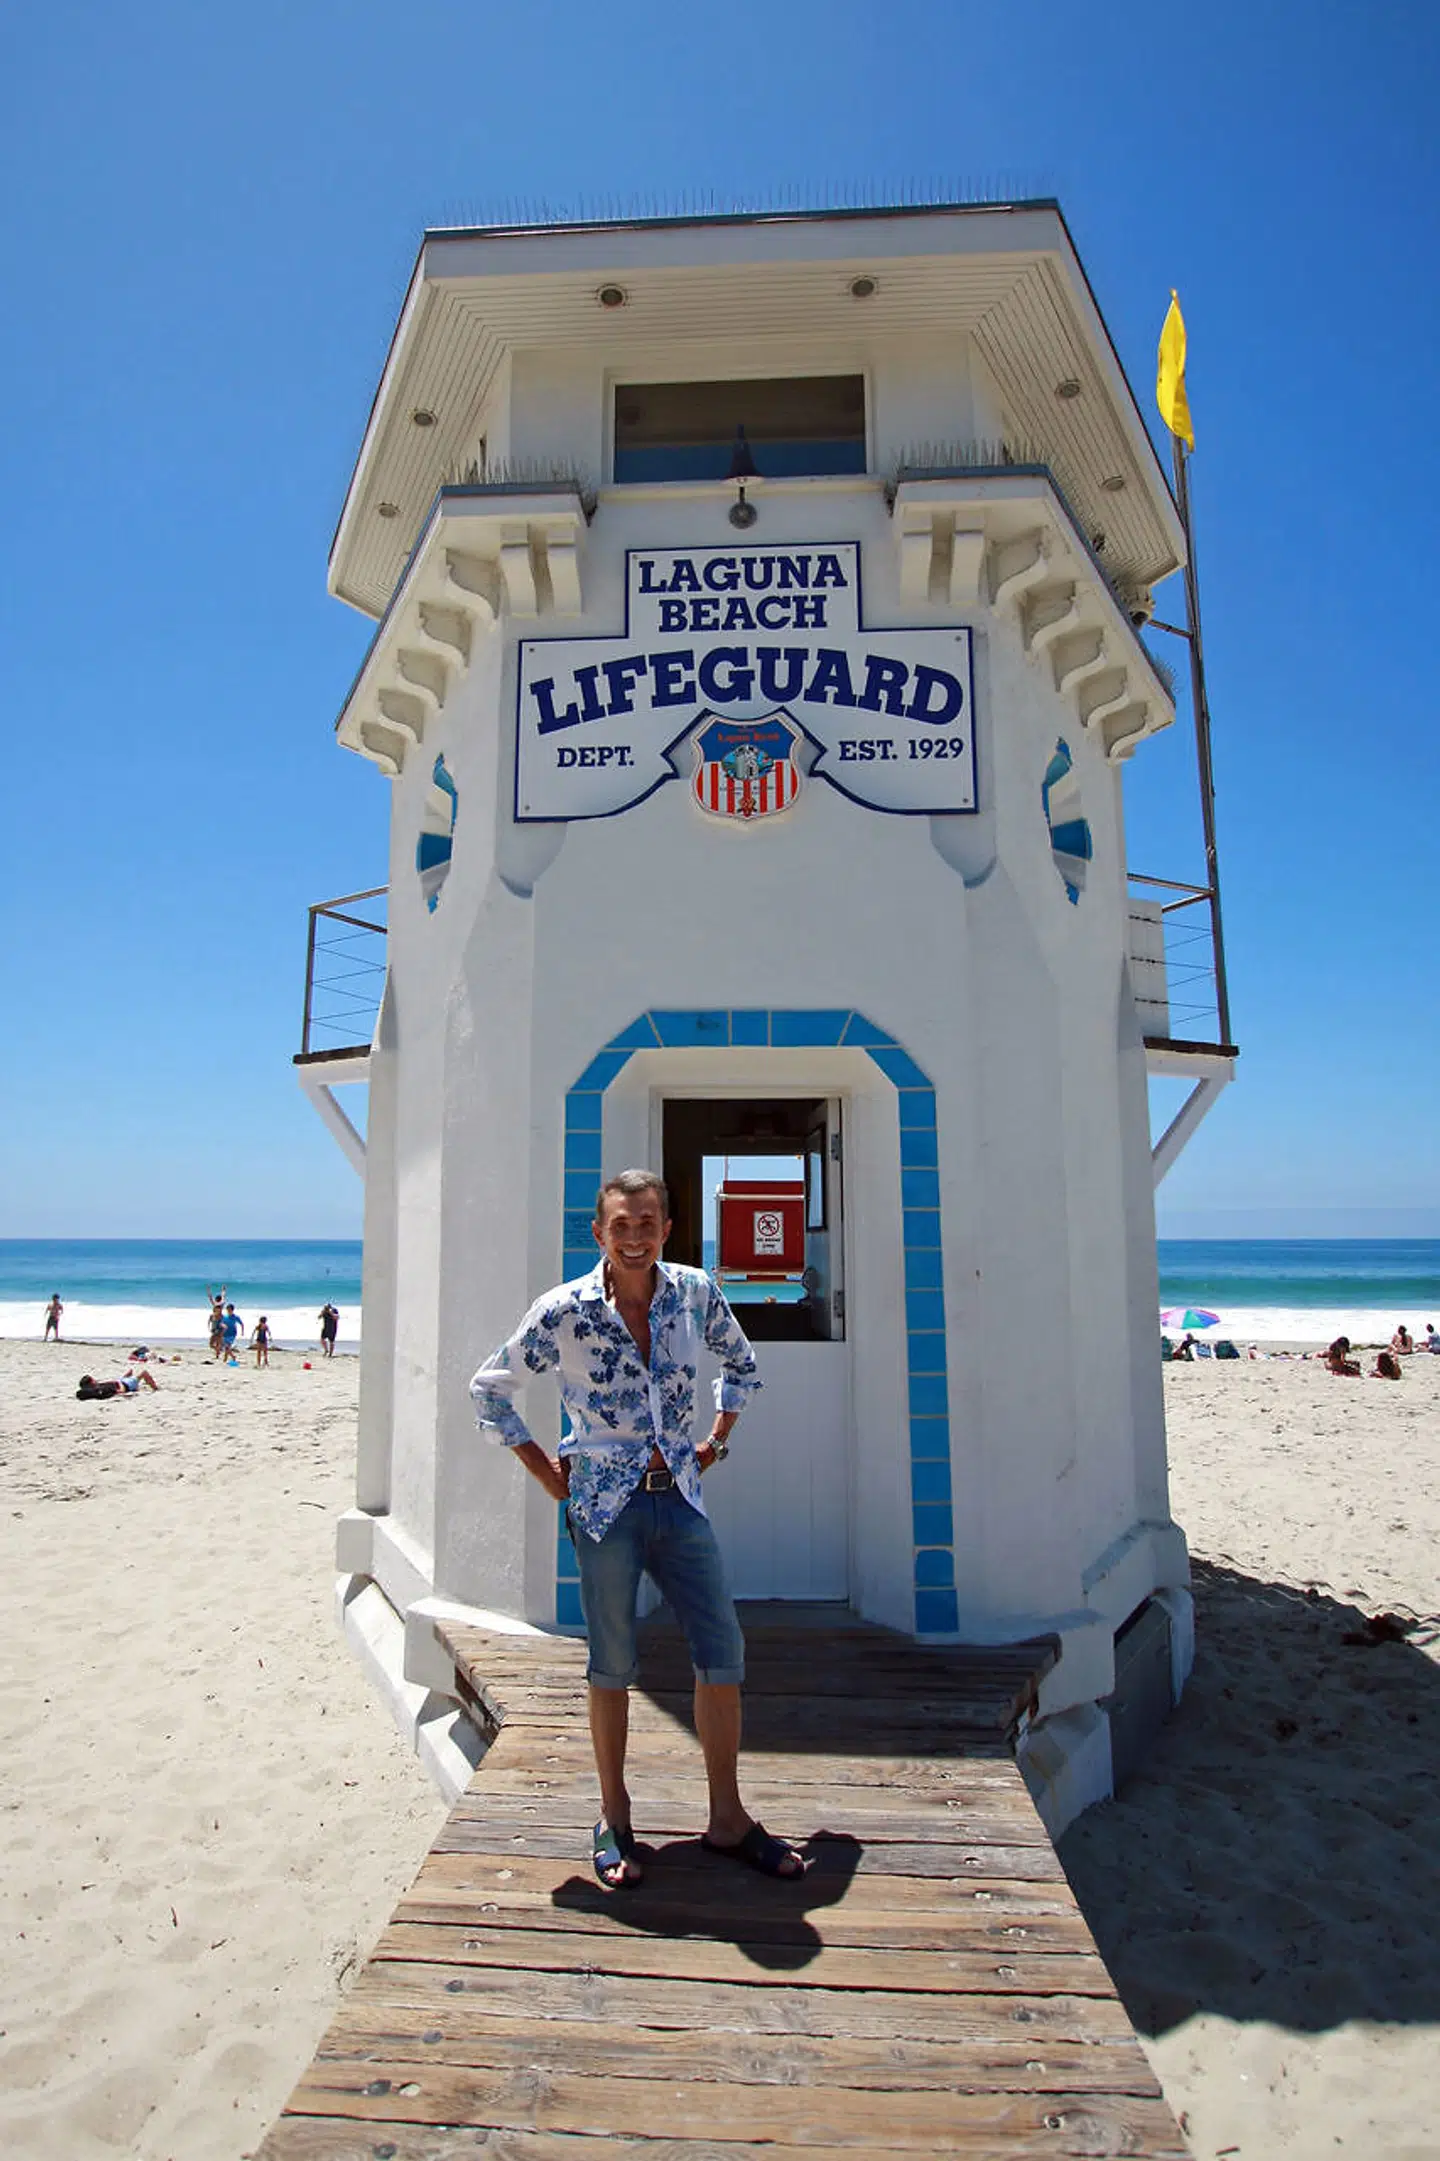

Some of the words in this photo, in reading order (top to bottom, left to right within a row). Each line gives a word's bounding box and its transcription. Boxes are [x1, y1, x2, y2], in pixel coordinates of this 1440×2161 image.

[638, 554, 848, 594] LAGUNA
[659, 595, 828, 633] BEACH
[529, 646, 964, 736] LIFEGUARD
[557, 746, 634, 768] DEPT.
[838, 739, 898, 762] EST.
[908, 738, 965, 760] 1929
